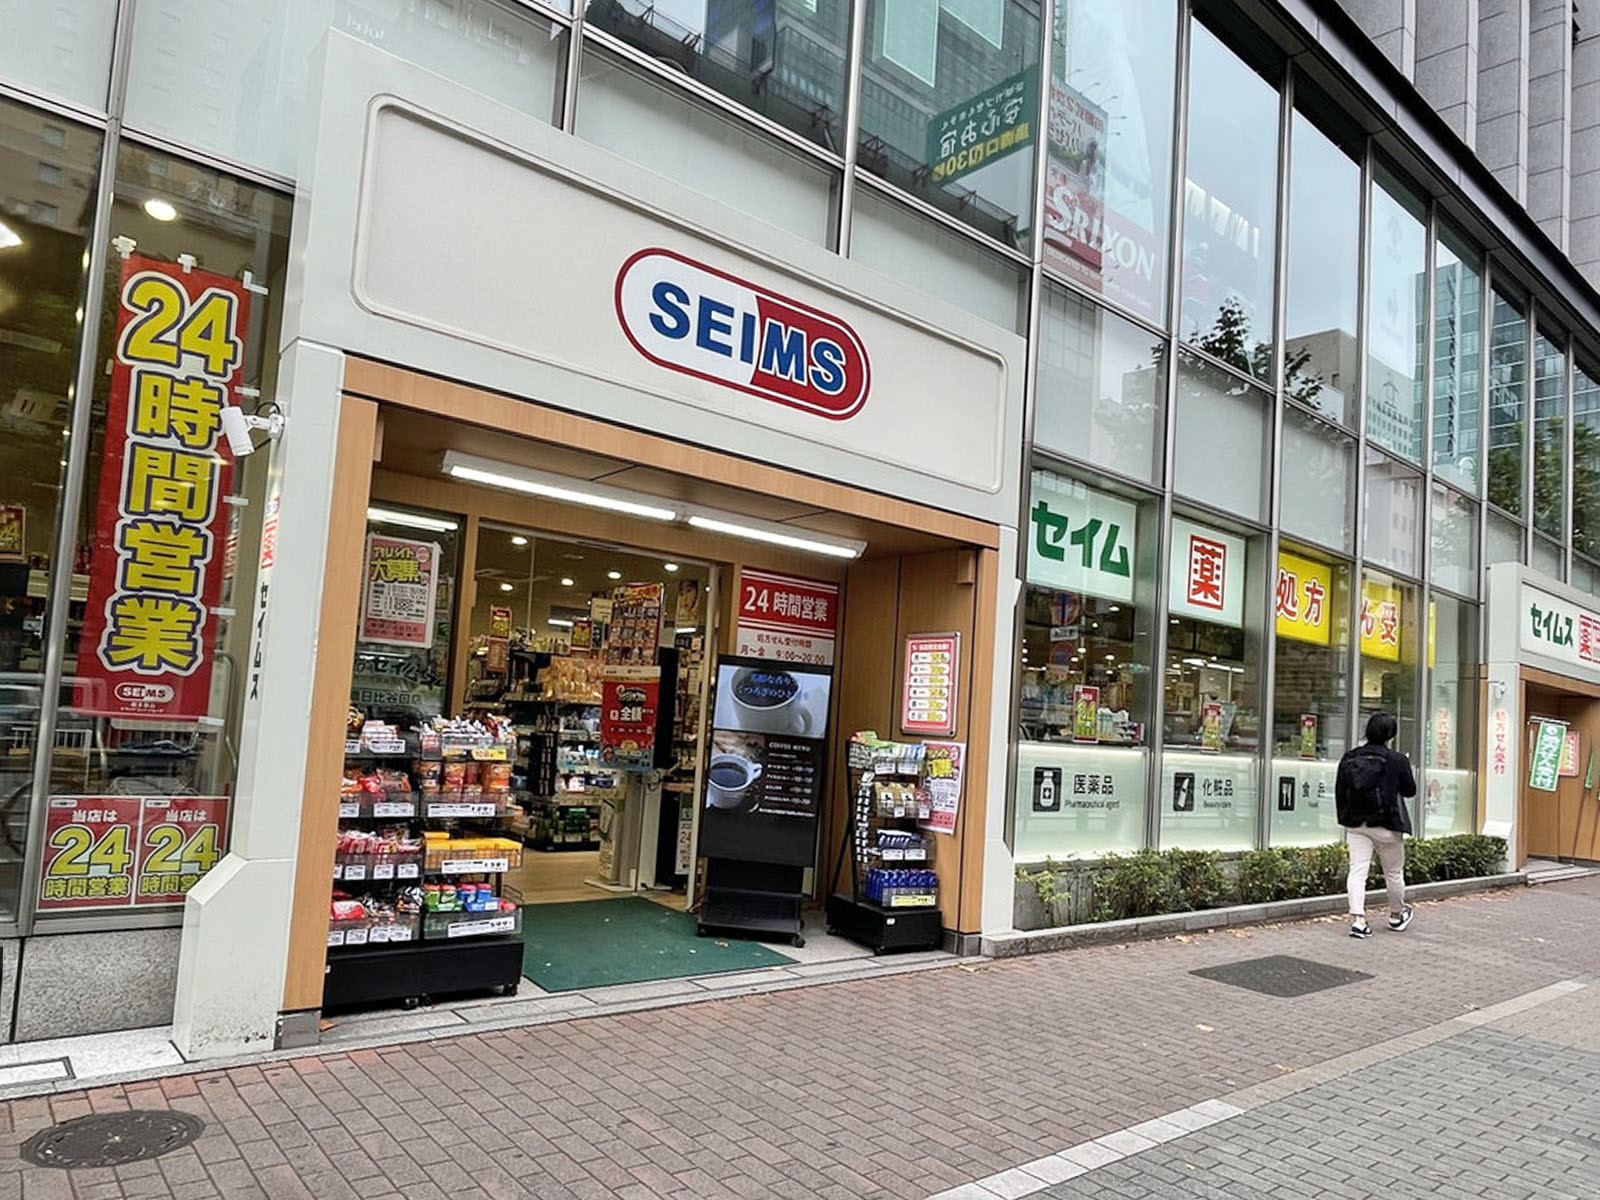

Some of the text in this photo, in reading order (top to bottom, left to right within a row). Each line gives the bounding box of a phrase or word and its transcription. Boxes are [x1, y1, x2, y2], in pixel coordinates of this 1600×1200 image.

[1049, 187, 1156, 281] SRIXON
[649, 281, 846, 394] SEIMS
[101, 273, 239, 673] 24時間営業
[1032, 500, 1130, 577] セイム
[1190, 542, 1222, 603] 薬
[1277, 569, 1325, 625] 処方
[250, 582, 269, 700] セイムス
[1531, 603, 1573, 647] セイムス
[122, 686, 166, 698] SEIMS
[1493, 709, 1507, 775] 処方せん受付
[1073, 774, 1114, 795] 医薬品
[1202, 778, 1233, 797] 化粧品
[72, 809, 118, 823] 当店は
[165, 809, 207, 823] 当店は
[50, 825, 131, 876] 24
[145, 825, 219, 873] 24
[43, 876, 130, 898] 時間営業
[141, 874, 204, 894] 時間営
